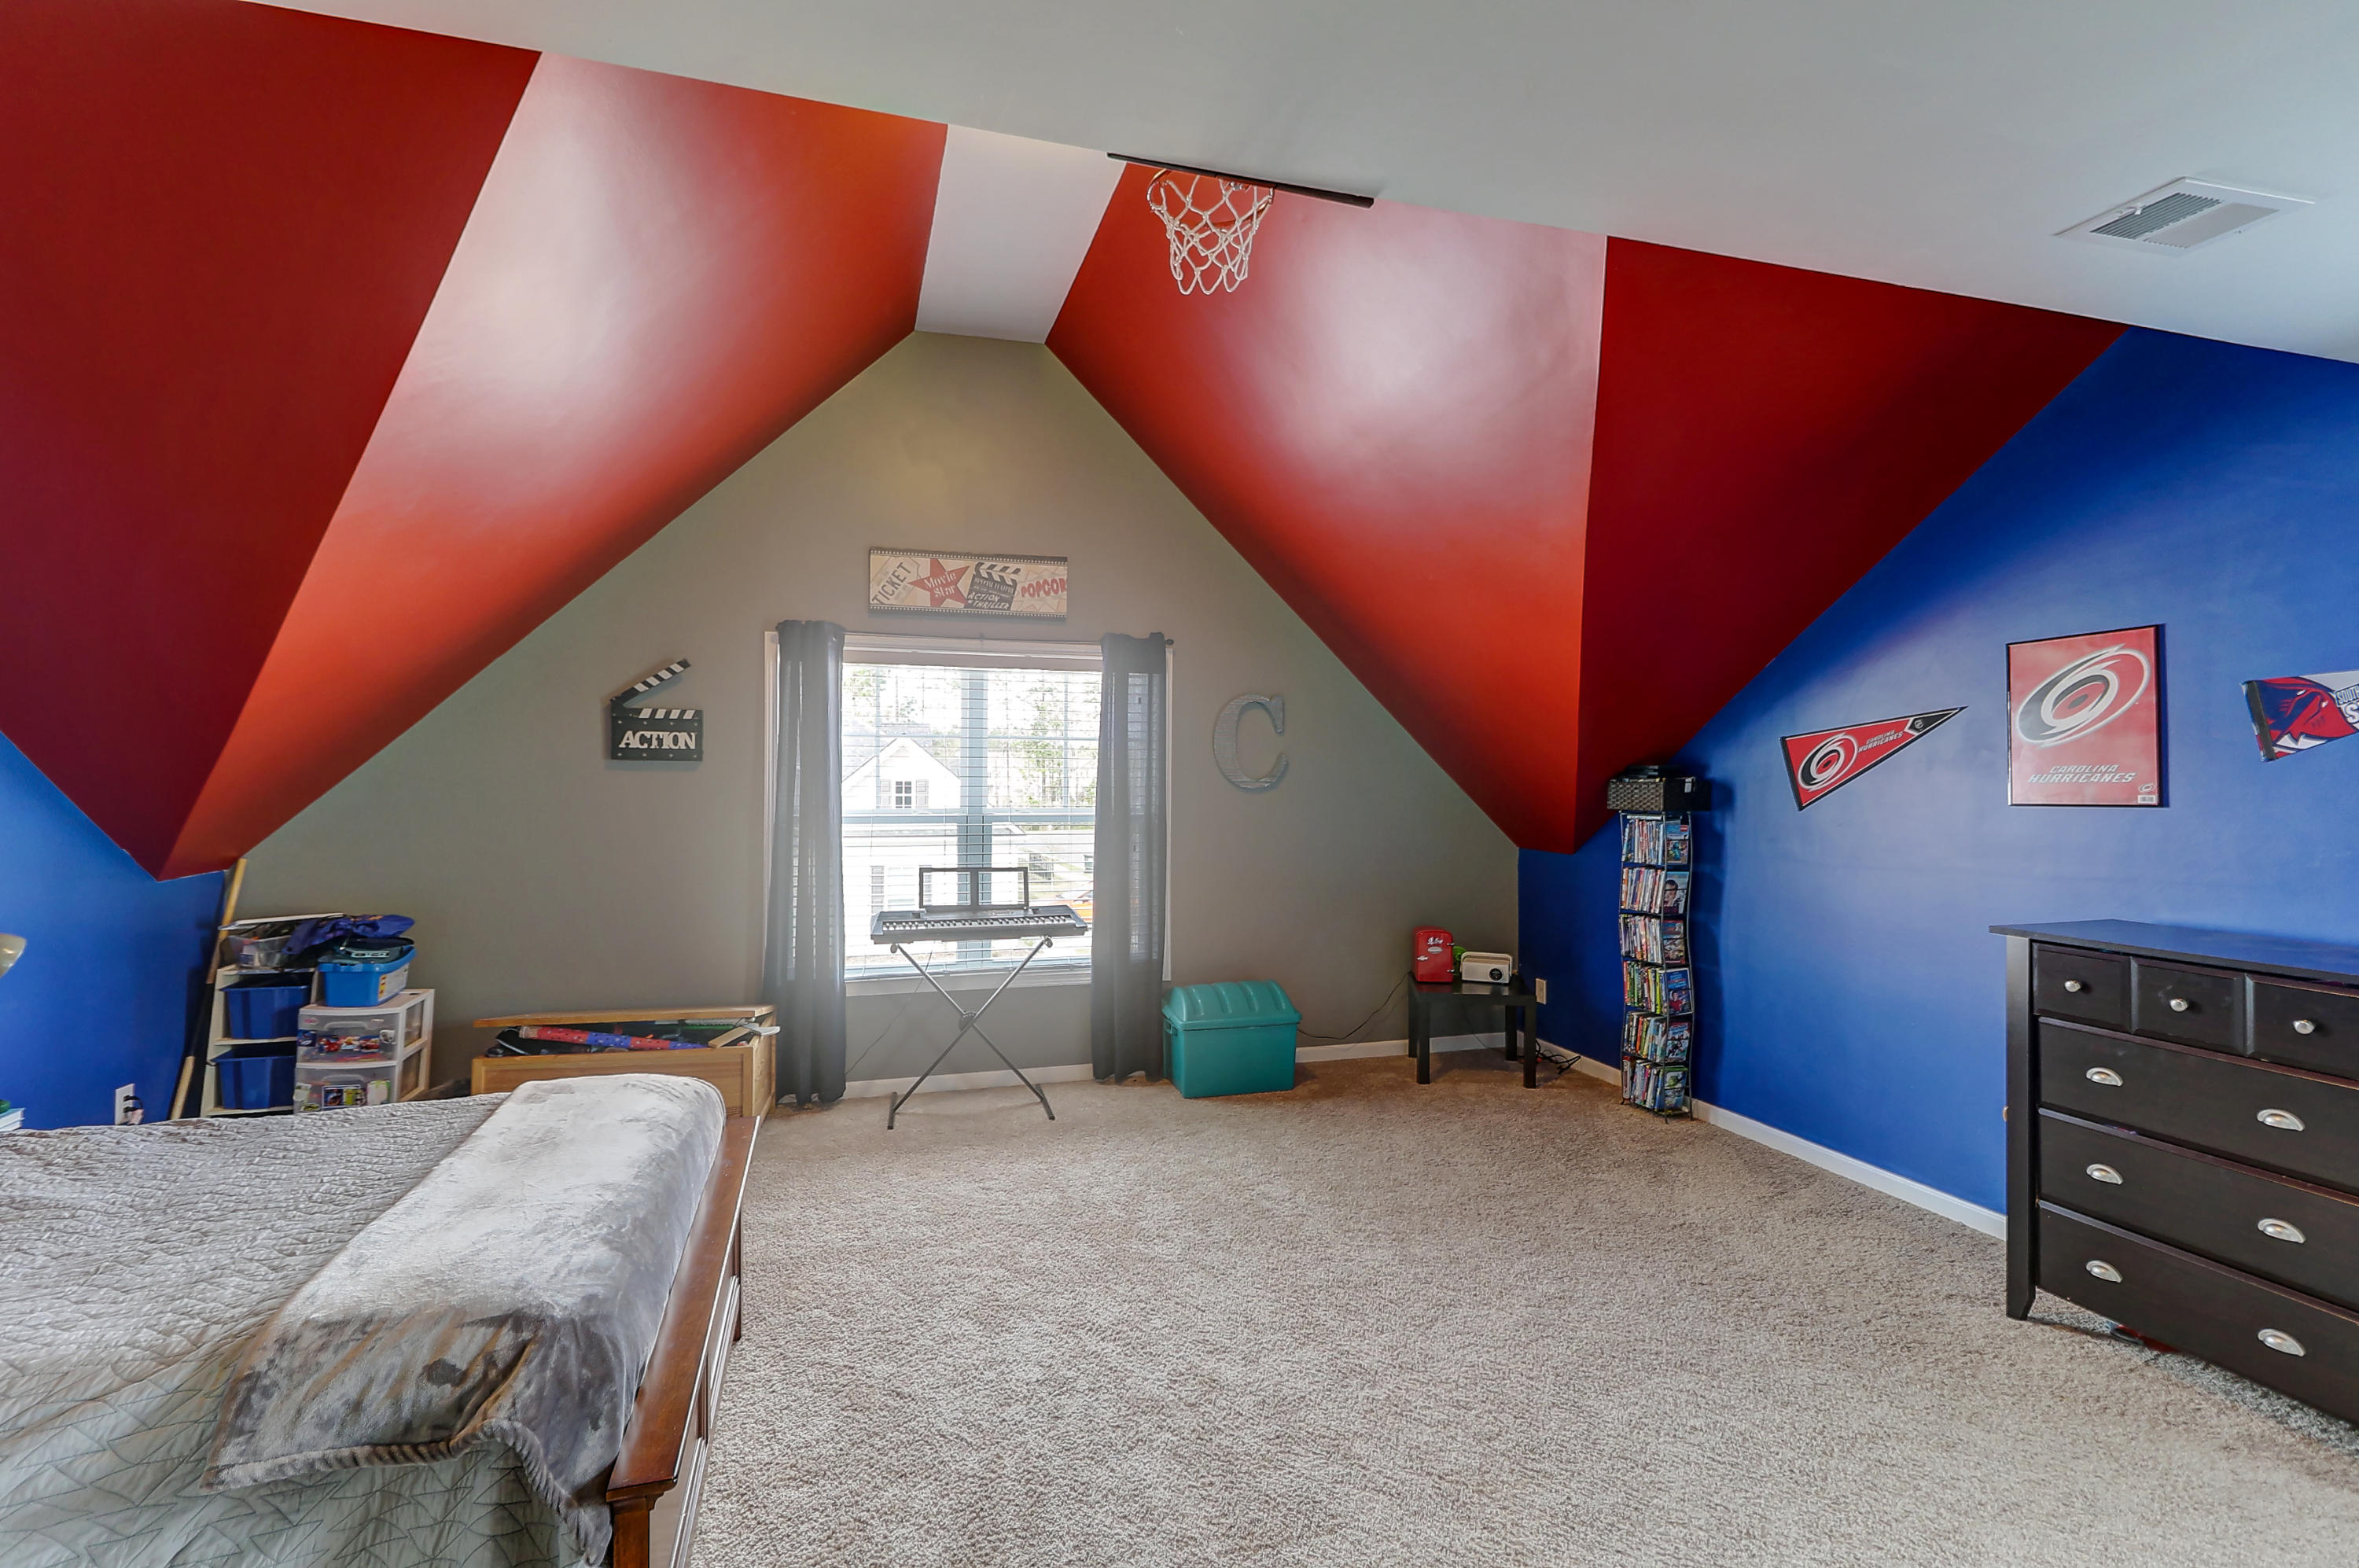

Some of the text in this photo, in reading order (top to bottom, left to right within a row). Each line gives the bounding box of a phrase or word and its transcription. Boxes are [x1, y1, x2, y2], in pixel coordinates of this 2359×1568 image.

[872, 562, 911, 605] TICKET
[924, 572, 956, 588] Movie
[967, 591, 1000, 602] ACTION
[973, 600, 1009, 610] THRILLER
[619, 731, 696, 749] ACTION
[1213, 694, 1288, 790] C
[1857, 731, 1904, 753] HURRICANES
[2049, 764, 2119, 774] CAROLINA
[2028, 772, 2136, 783] HURRICANES
